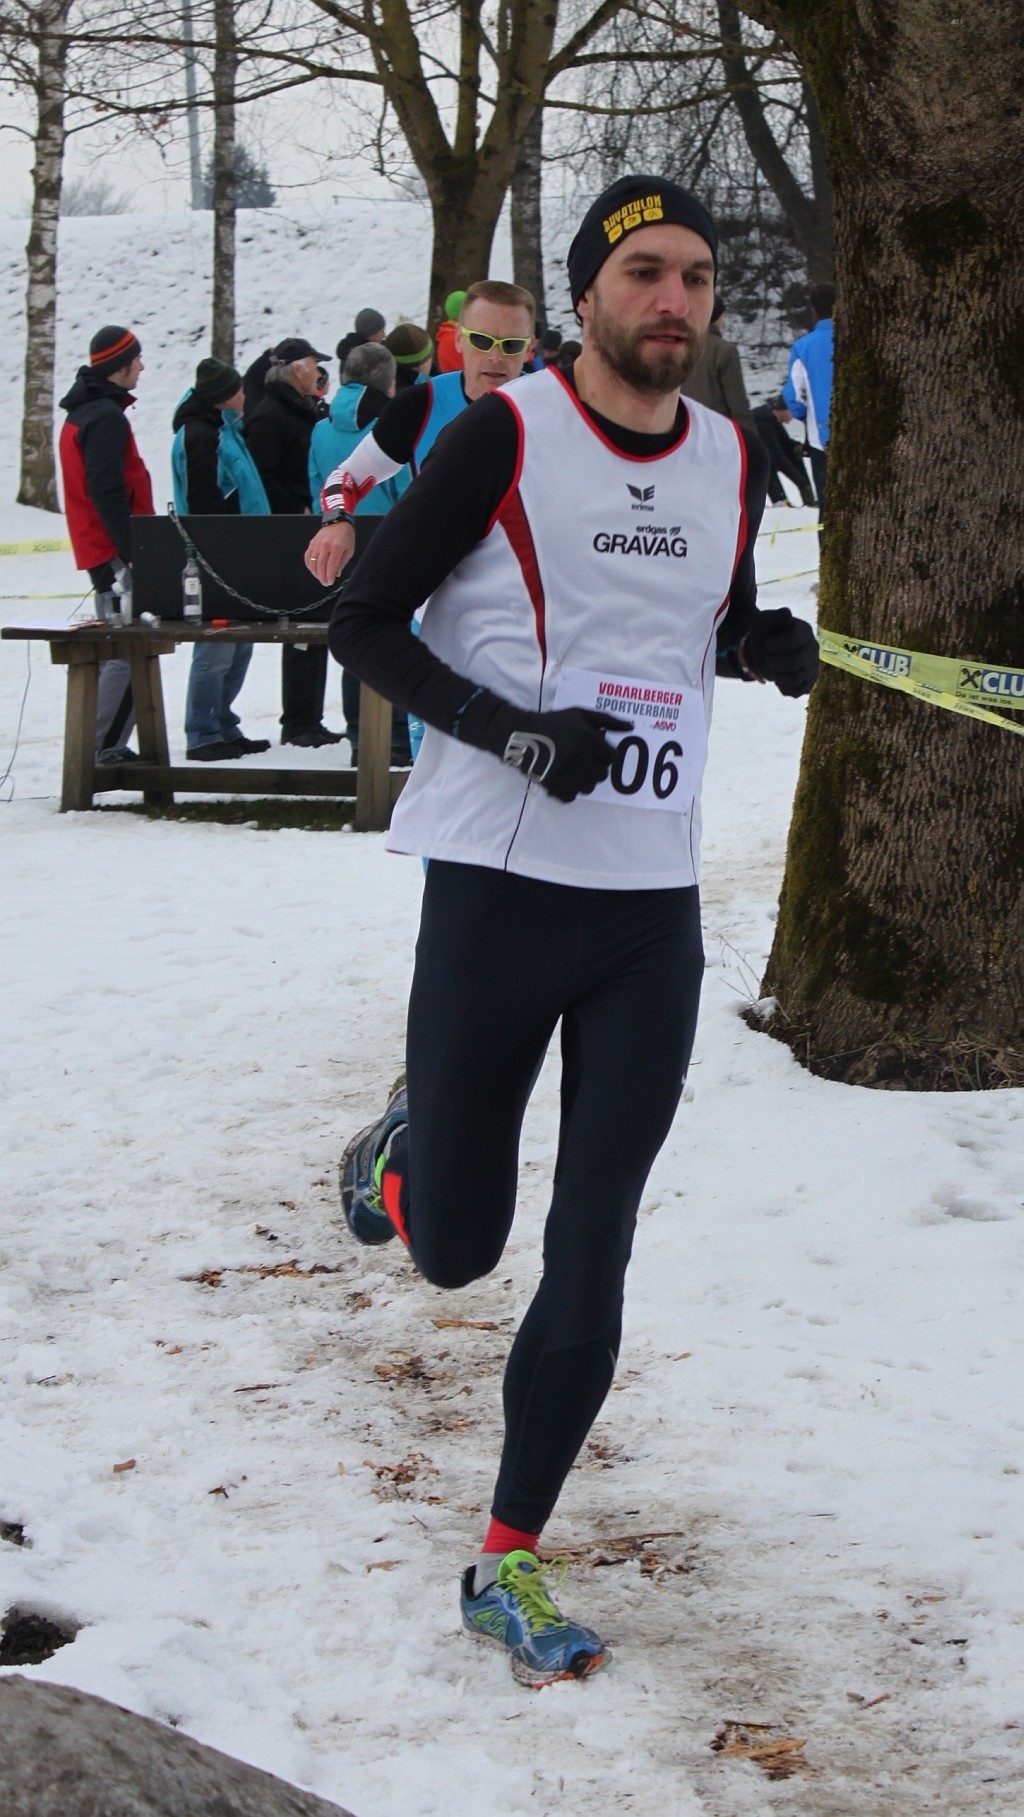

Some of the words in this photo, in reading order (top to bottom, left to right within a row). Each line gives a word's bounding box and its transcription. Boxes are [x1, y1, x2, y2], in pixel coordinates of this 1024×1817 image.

[636, 525, 668, 535] erdgas
[593, 532, 688, 558] GRAVAG
[598, 681, 683, 706] VORARLBERGER
[595, 696, 680, 720] SPORTVERBAND
[600, 730, 684, 800] 06
